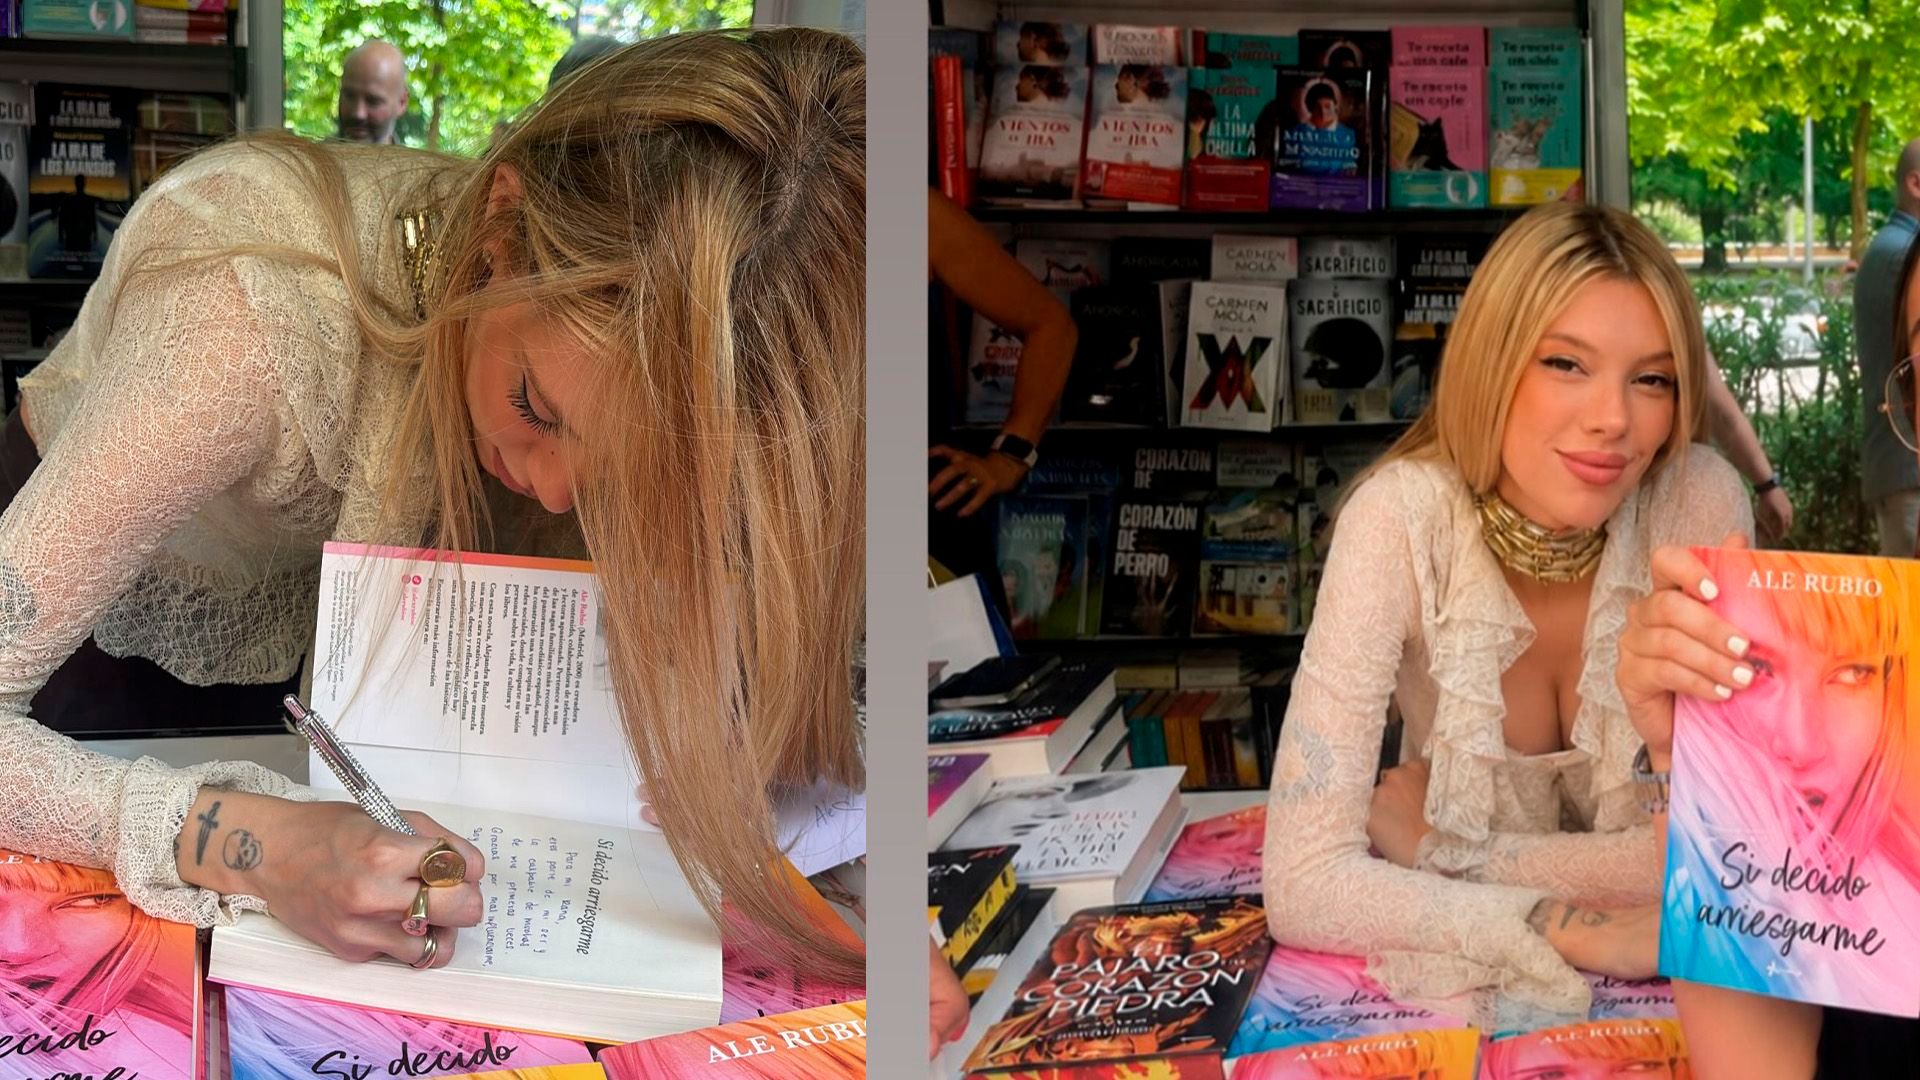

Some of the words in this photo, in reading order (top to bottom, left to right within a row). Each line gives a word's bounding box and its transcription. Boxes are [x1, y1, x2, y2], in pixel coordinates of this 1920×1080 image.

[1224, 102, 1241, 121] LA
[1205, 137, 1257, 157] ORILLA
[1225, 248, 1286, 262] CARMEN
[1234, 261, 1277, 274] MOLA
[1304, 256, 1387, 274] SACRIFICIO
[1205, 296, 1269, 313] CARMEN
[1213, 309, 1257, 324] MOLA
[1297, 299, 1382, 316] SACRIFICIO
[1134, 470, 1152, 489] DE
[1119, 502, 1198, 531] CORAZÓN
[1116, 528, 1138, 551] DE
[1114, 552, 1169, 578] PERRO
[488, 582, 496, 598] Con
[522, 584, 530, 605] redes
[580, 589, 588, 602] Ale
[1747, 569, 1796, 591] ALE
[1804, 573, 1883, 597] RUBIO
[433, 578, 443, 623] Encontrarás
[467, 580, 477, 615] emoción,
[487, 598, 495, 614] esta
[502, 595, 510, 619] libros.
[510, 583, 521, 616] personal
[550, 597, 558, 609] las
[559, 593, 568, 620] lectora
[466, 615, 475, 637] deseo
[510, 617, 518, 638] sobre
[519, 606, 529, 638] sociales,
[529, 596, 539, 636] construido
[538, 599, 547, 637] panorama
[547, 610, 556, 631] sagas
[567, 599, 577, 638] contenido,
[578, 603, 587, 625] Rubio
[432, 624, 440, 641] más
[485, 615, 494, 642] novela,
[446, 629, 455, 658] amante
[473, 637, 483, 669] creativa,
[518, 639, 526, 662] donde
[546, 632, 556, 670] familiares
[555, 620, 566, 666] apasionada.
[574, 626, 585, 659] (Madrid,
[429, 641, 439, 687] información
[463, 644, 473, 679] reflexión,
[481, 642, 492, 679] Alejandra
[507, 648, 516, 666] vida,
[536, 638, 546, 676] mediático
[564, 638, 575, 688] colaboradora
[444, 669, 452, 681] las
[514, 663, 525, 699] comparte
[524, 666, 534, 692] propia
[545, 671, 553, 687] más
[554, 667, 563, 704] Pertenece
[461, 686, 470, 720] confirma
[470, 689, 478, 703] que
[481, 680, 490, 703] Rubio
[506, 676, 514, 703] cultura
[533, 676, 543, 708] español,
[450, 698, 459, 712] hay
[470, 704, 478, 731] mezcla
[524, 703, 532, 715] las
[542, 688, 552, 733] reconocidas
[561, 700, 571, 735] televisión
[572, 690, 581, 723] creadora
[479, 704, 488, 735] muestra
[513, 711, 522, 733] visión
[531, 709, 540, 737] aunque
[490, 826, 502, 860] Gracias
[512, 838, 523, 846] de
[597, 838, 615, 851] Si
[564, 851, 577, 870] Para
[590, 851, 613, 886] decido
[1720, 841, 1762, 891] Si
[1771, 846, 1871, 898] decido
[487, 873, 498, 886] por
[524, 901, 538, 911] de
[543, 889, 553, 898] de
[576, 886, 603, 955] arriesgarme
[1696, 903, 1887, 957] arriesgarme
[1047, 987, 1214, 1018] PIEDRA
[0, 1014, 117, 1058] ecido
[708, 1035, 776, 1064] ALE
[1294, 1048, 1339, 1061] ALE
[1346, 1038, 1420, 1055] RUBIO
[312, 1048, 372, 1080] Si
[388, 1031, 519, 1078] decido
